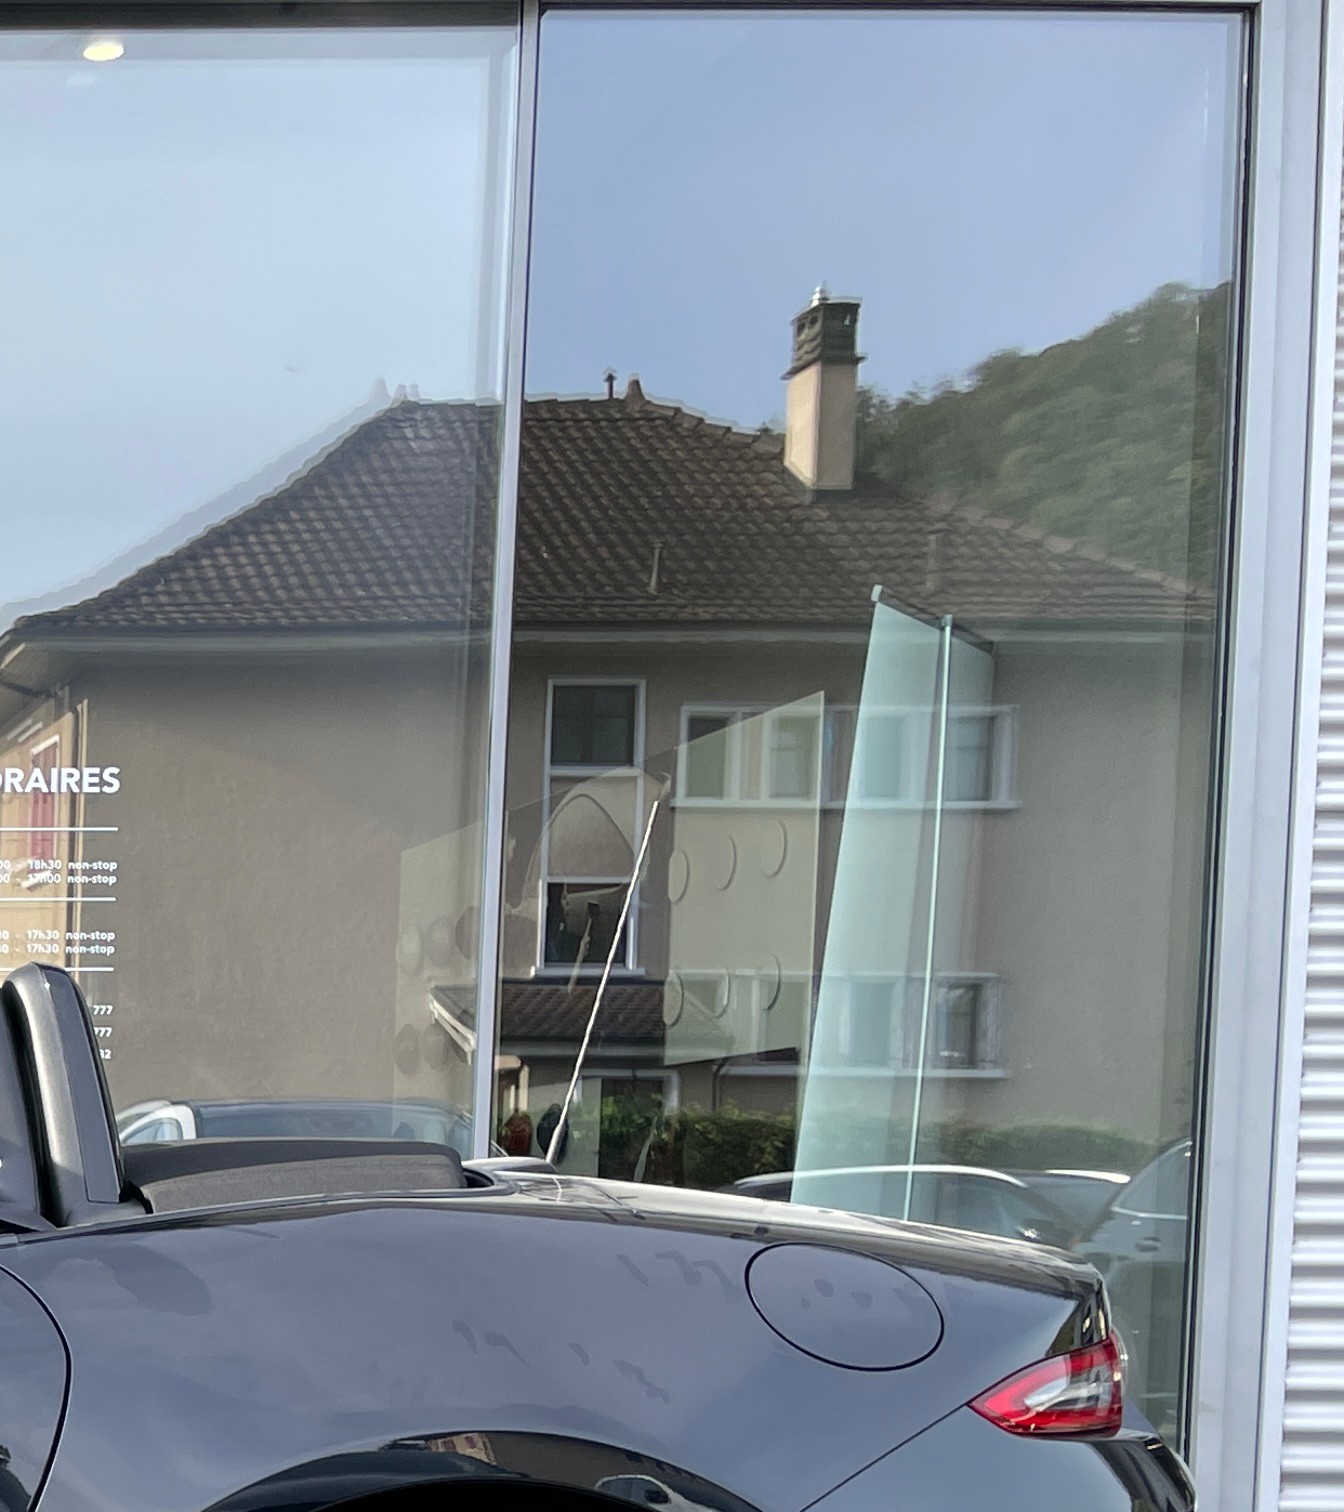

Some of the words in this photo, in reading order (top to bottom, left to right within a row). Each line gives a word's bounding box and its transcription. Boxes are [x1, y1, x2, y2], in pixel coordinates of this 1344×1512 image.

[68, 860, 117, 872] non-stop
[67, 874, 117, 886] non-stop
[26, 930, 60, 940] 17h30
[65, 931, 115, 943] non-stop
[26, 944, 59, 954] 17h30
[65, 944, 115, 956] non-stop
